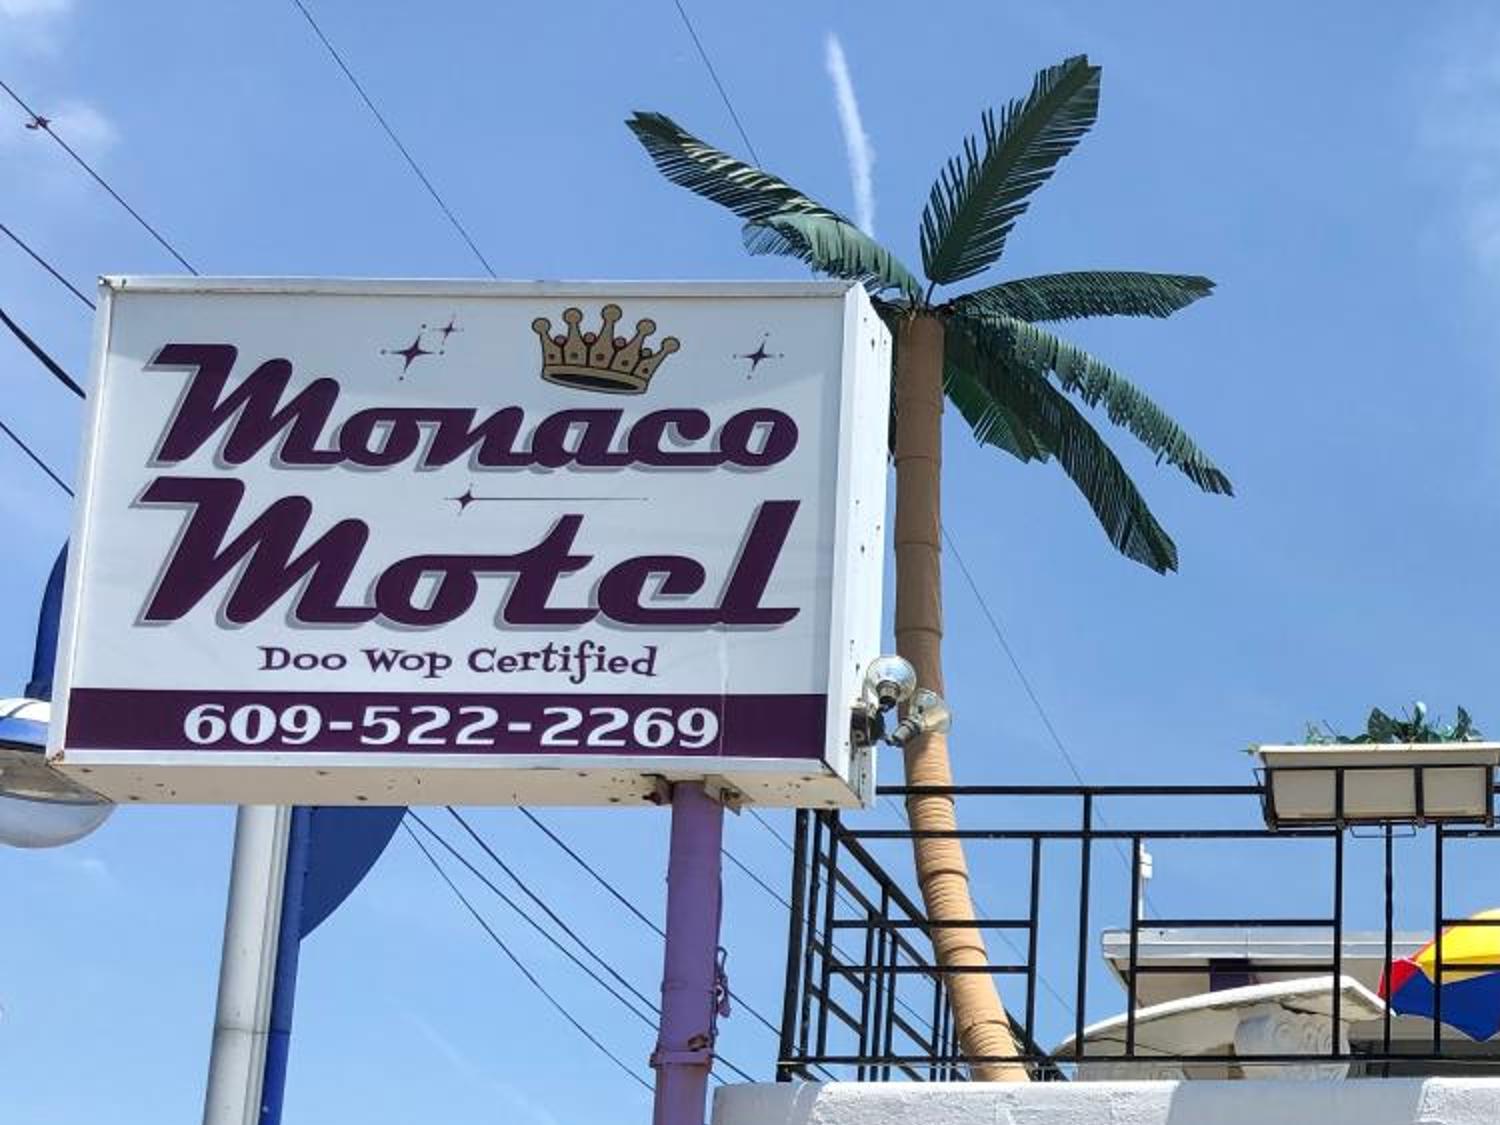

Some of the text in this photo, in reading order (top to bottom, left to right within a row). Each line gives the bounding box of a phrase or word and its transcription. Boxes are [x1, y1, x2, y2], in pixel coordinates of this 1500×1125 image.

[145, 342, 800, 471] Monaco
[133, 476, 802, 630] Motel
[257, 639, 660, 685] Doo Wop Certified
[183, 703, 720, 750] 609-522-2269
